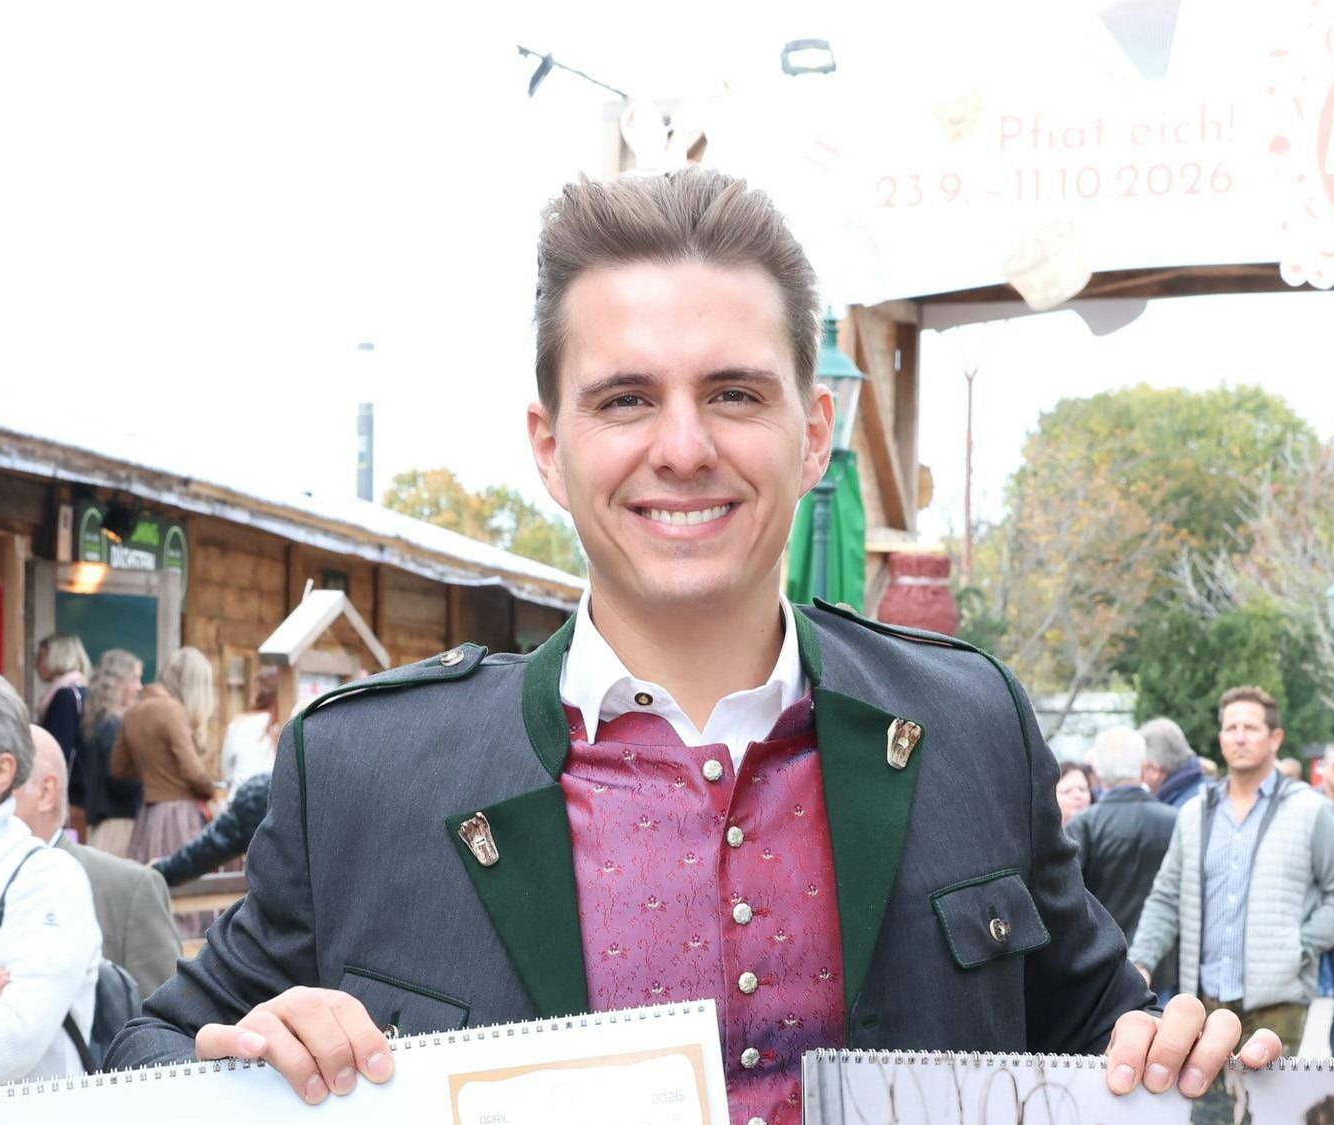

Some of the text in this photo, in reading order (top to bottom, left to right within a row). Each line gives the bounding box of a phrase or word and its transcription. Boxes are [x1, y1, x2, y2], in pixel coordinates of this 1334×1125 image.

[1000, 102, 1235, 151] Pfiat eich!
[875, 172, 970, 208] 23.9.
[651, 1091, 683, 1104] 2026
